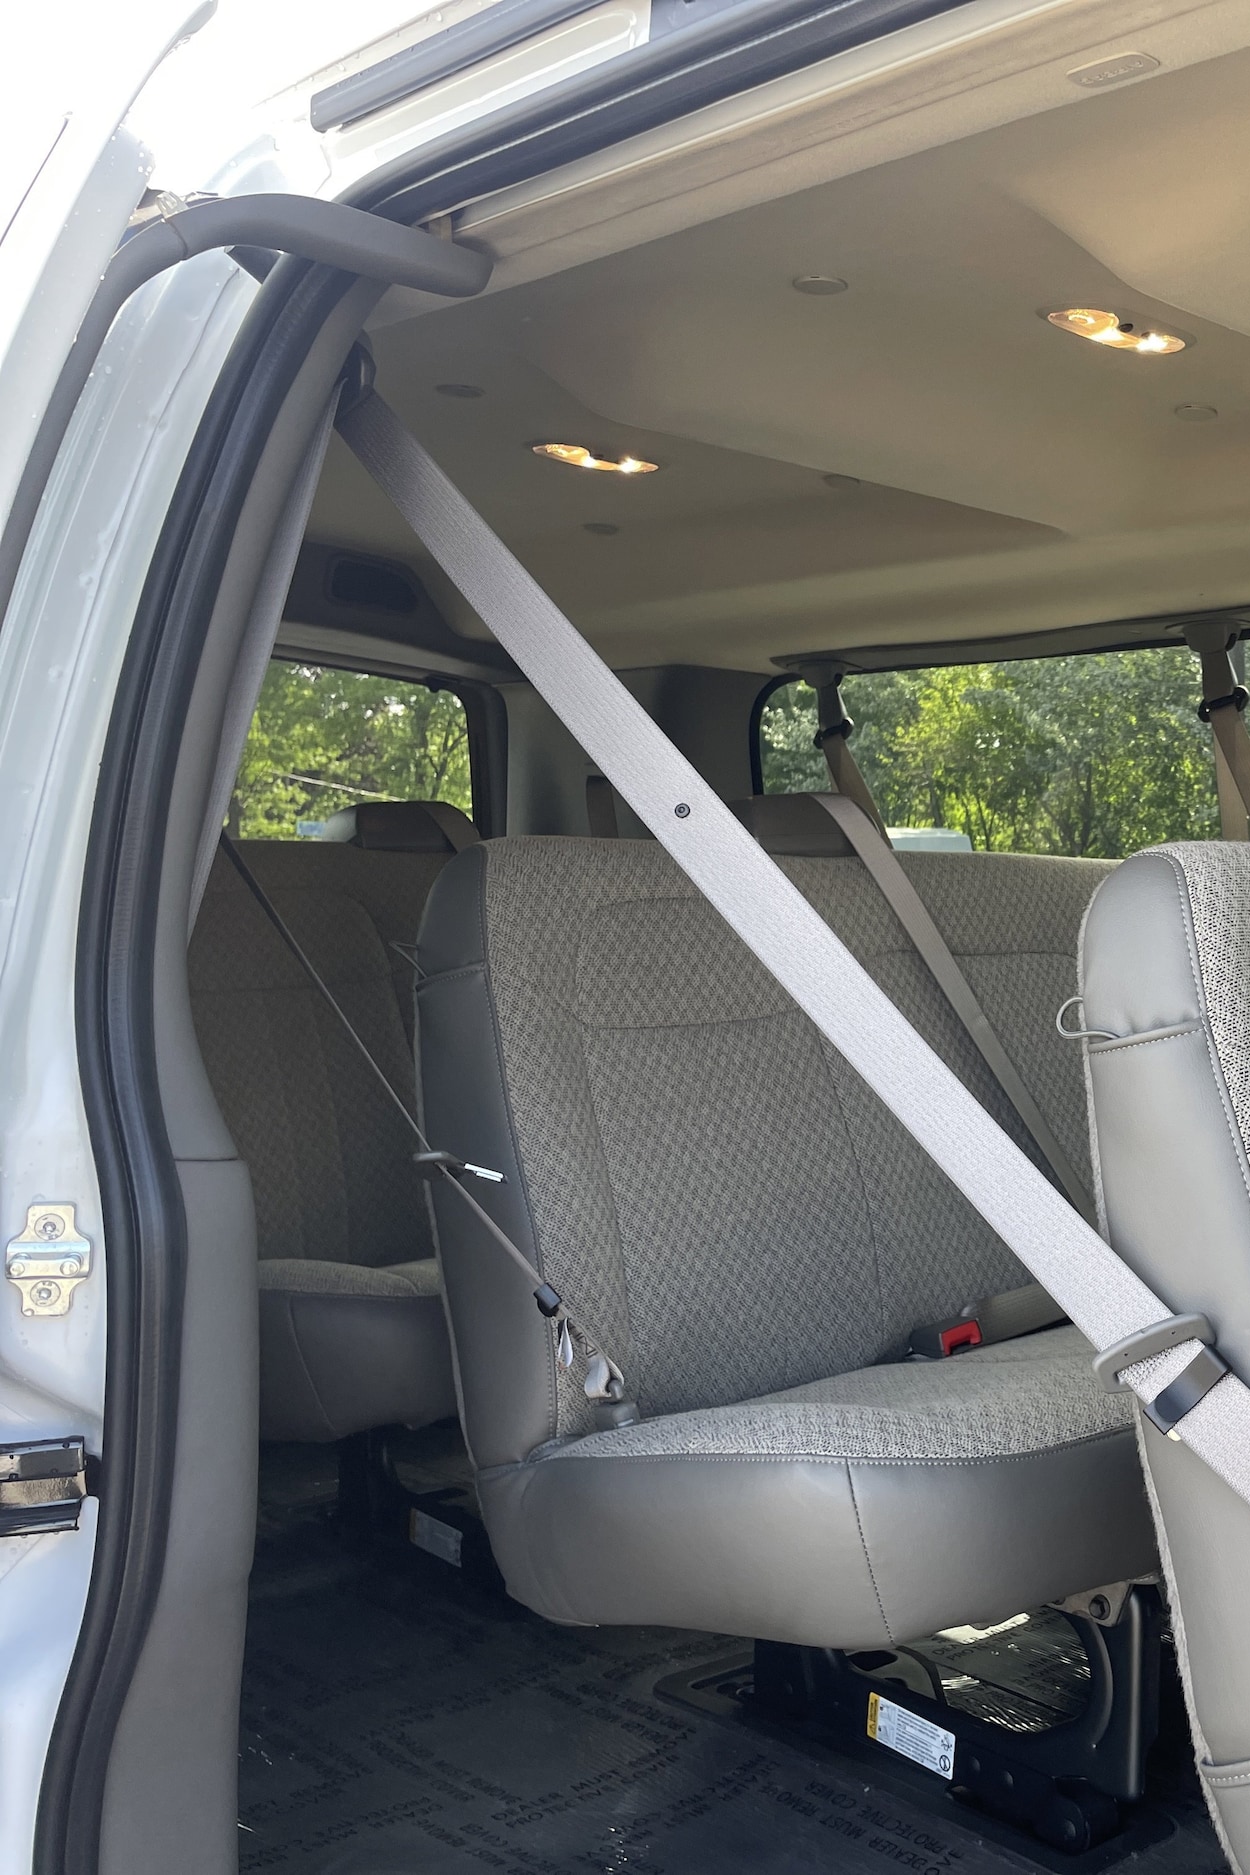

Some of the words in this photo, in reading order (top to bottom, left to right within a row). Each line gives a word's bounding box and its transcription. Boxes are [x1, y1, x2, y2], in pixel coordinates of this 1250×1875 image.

[491, 1791, 564, 1821] DEALER
[570, 1769, 624, 1793] MUST
[804, 1780, 857, 1809] COVER
[819, 1814, 867, 1840] MUST
[859, 1805, 948, 1855] PROTECTIVE
[868, 1835, 928, 1871] DEALER
